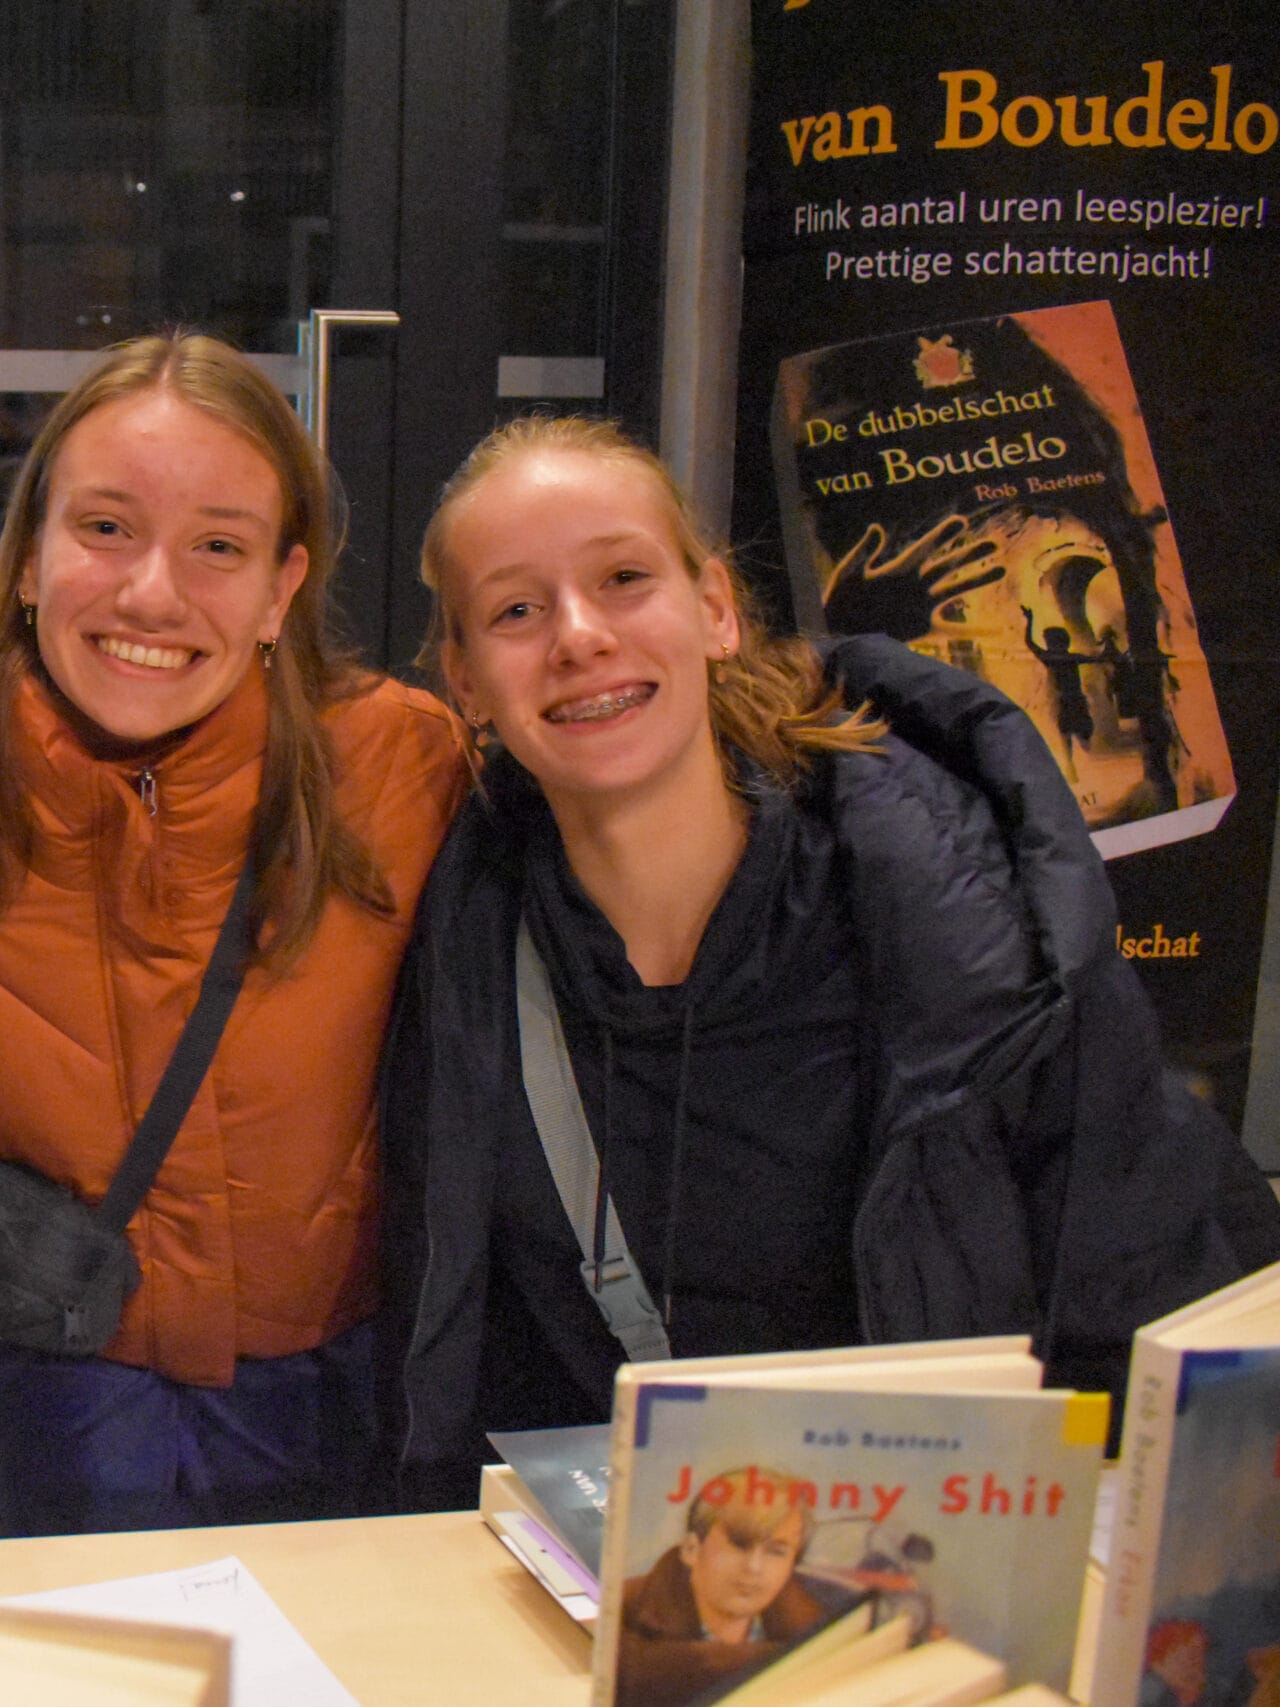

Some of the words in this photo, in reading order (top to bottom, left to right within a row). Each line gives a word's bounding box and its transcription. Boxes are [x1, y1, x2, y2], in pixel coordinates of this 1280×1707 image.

[781, 102, 897, 166] van
[935, 60, 1279, 154] Boudelo
[795, 200, 851, 235] Flink
[861, 191, 965, 227] aantal
[980, 197, 1061, 223] uren
[1076, 190, 1265, 230] leesplezier!
[827, 246, 951, 283] Prettige
[965, 243, 1210, 282] schattenjacht!
[806, 419, 847, 448] De
[859, 384, 1055, 438] dubbelschat
[816, 469, 872, 495] van
[880, 430, 1067, 486] Boudelo
[975, 481, 1018, 502] Rob
[1026, 468, 1105, 494] Baetens
[1116, 924, 1201, 959] lschat
[668, 1465, 907, 1524] Johnny
[939, 1473, 1065, 1517] Shit
